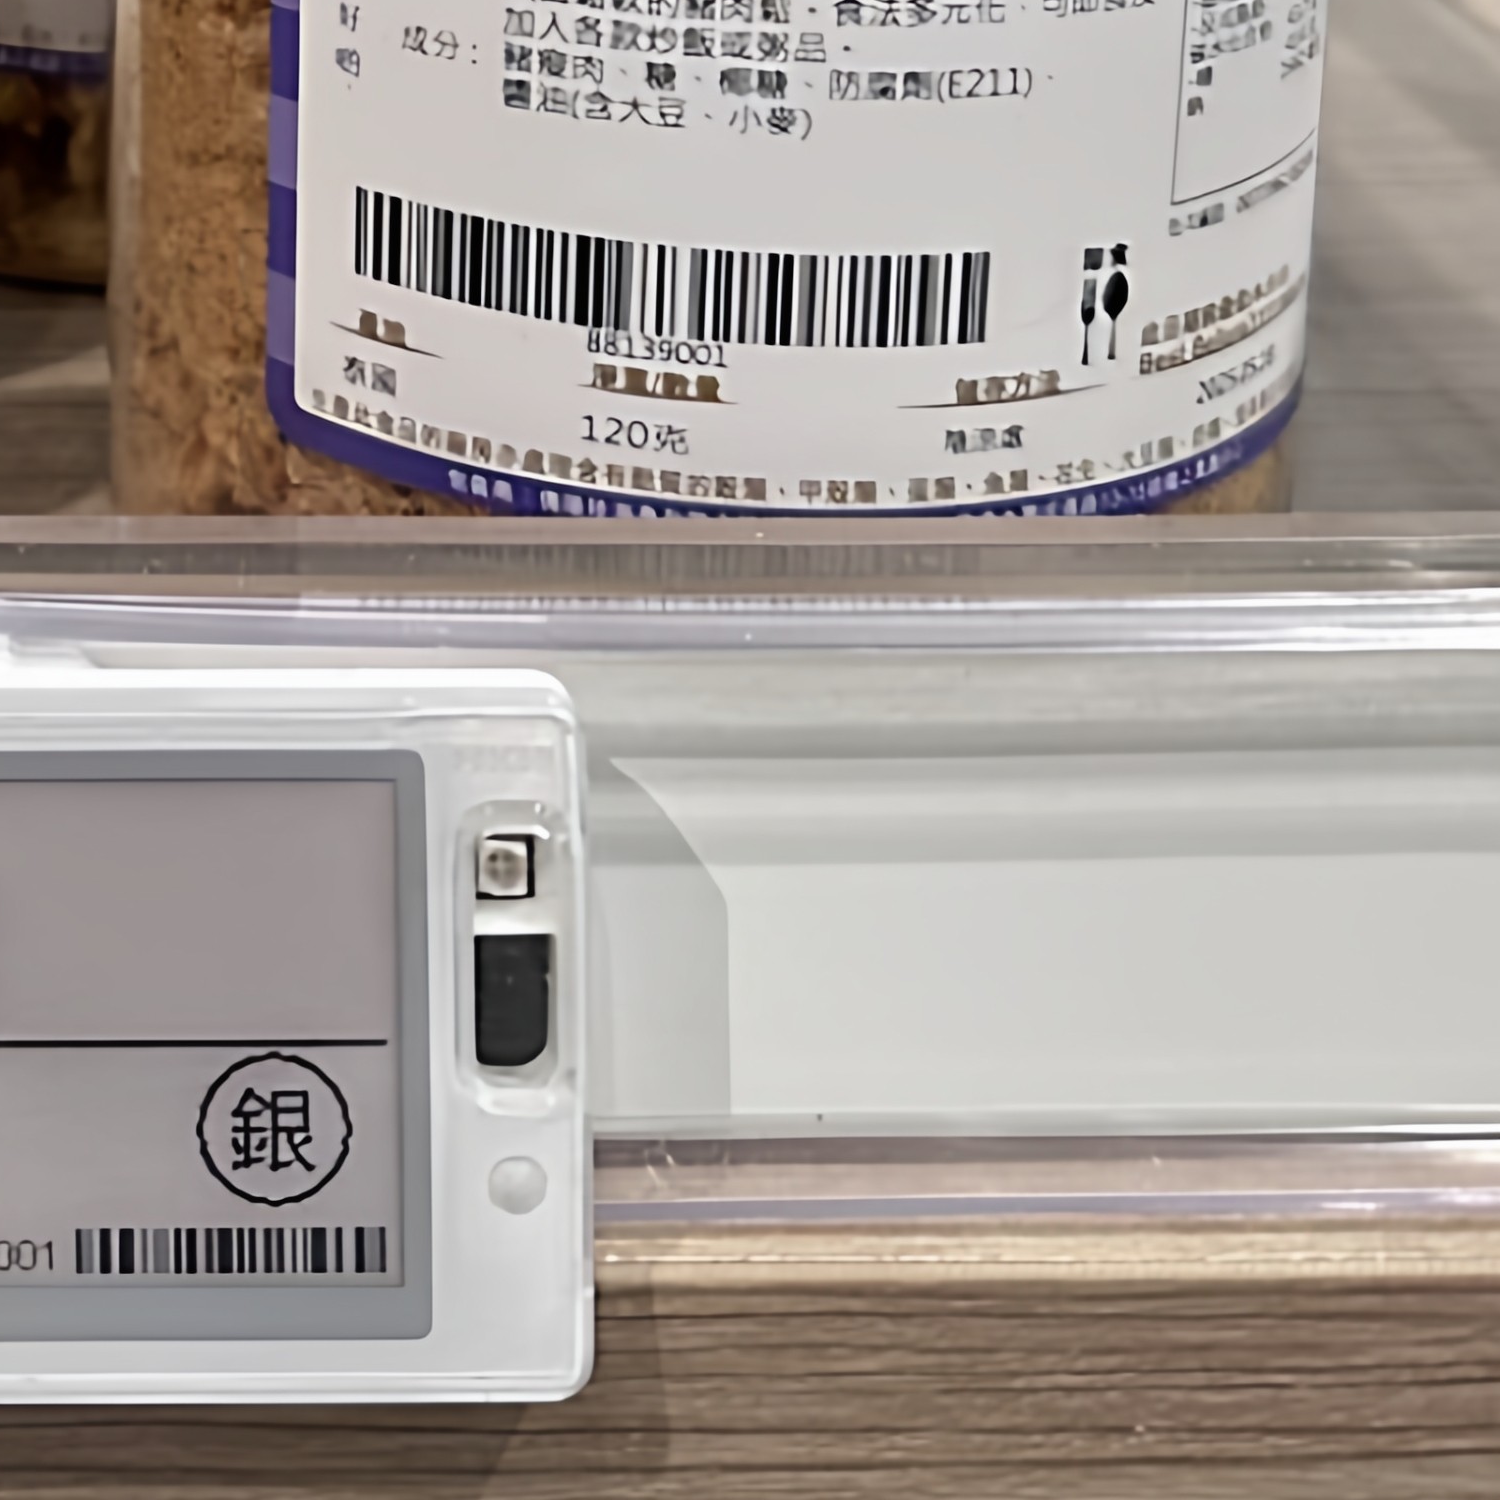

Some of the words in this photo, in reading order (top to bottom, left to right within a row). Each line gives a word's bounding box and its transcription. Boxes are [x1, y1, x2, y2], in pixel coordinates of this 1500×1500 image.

[587, 329, 728, 368] 88139001
[580, 414, 690, 455] 120克
[230, 1086, 316, 1174] 銀
